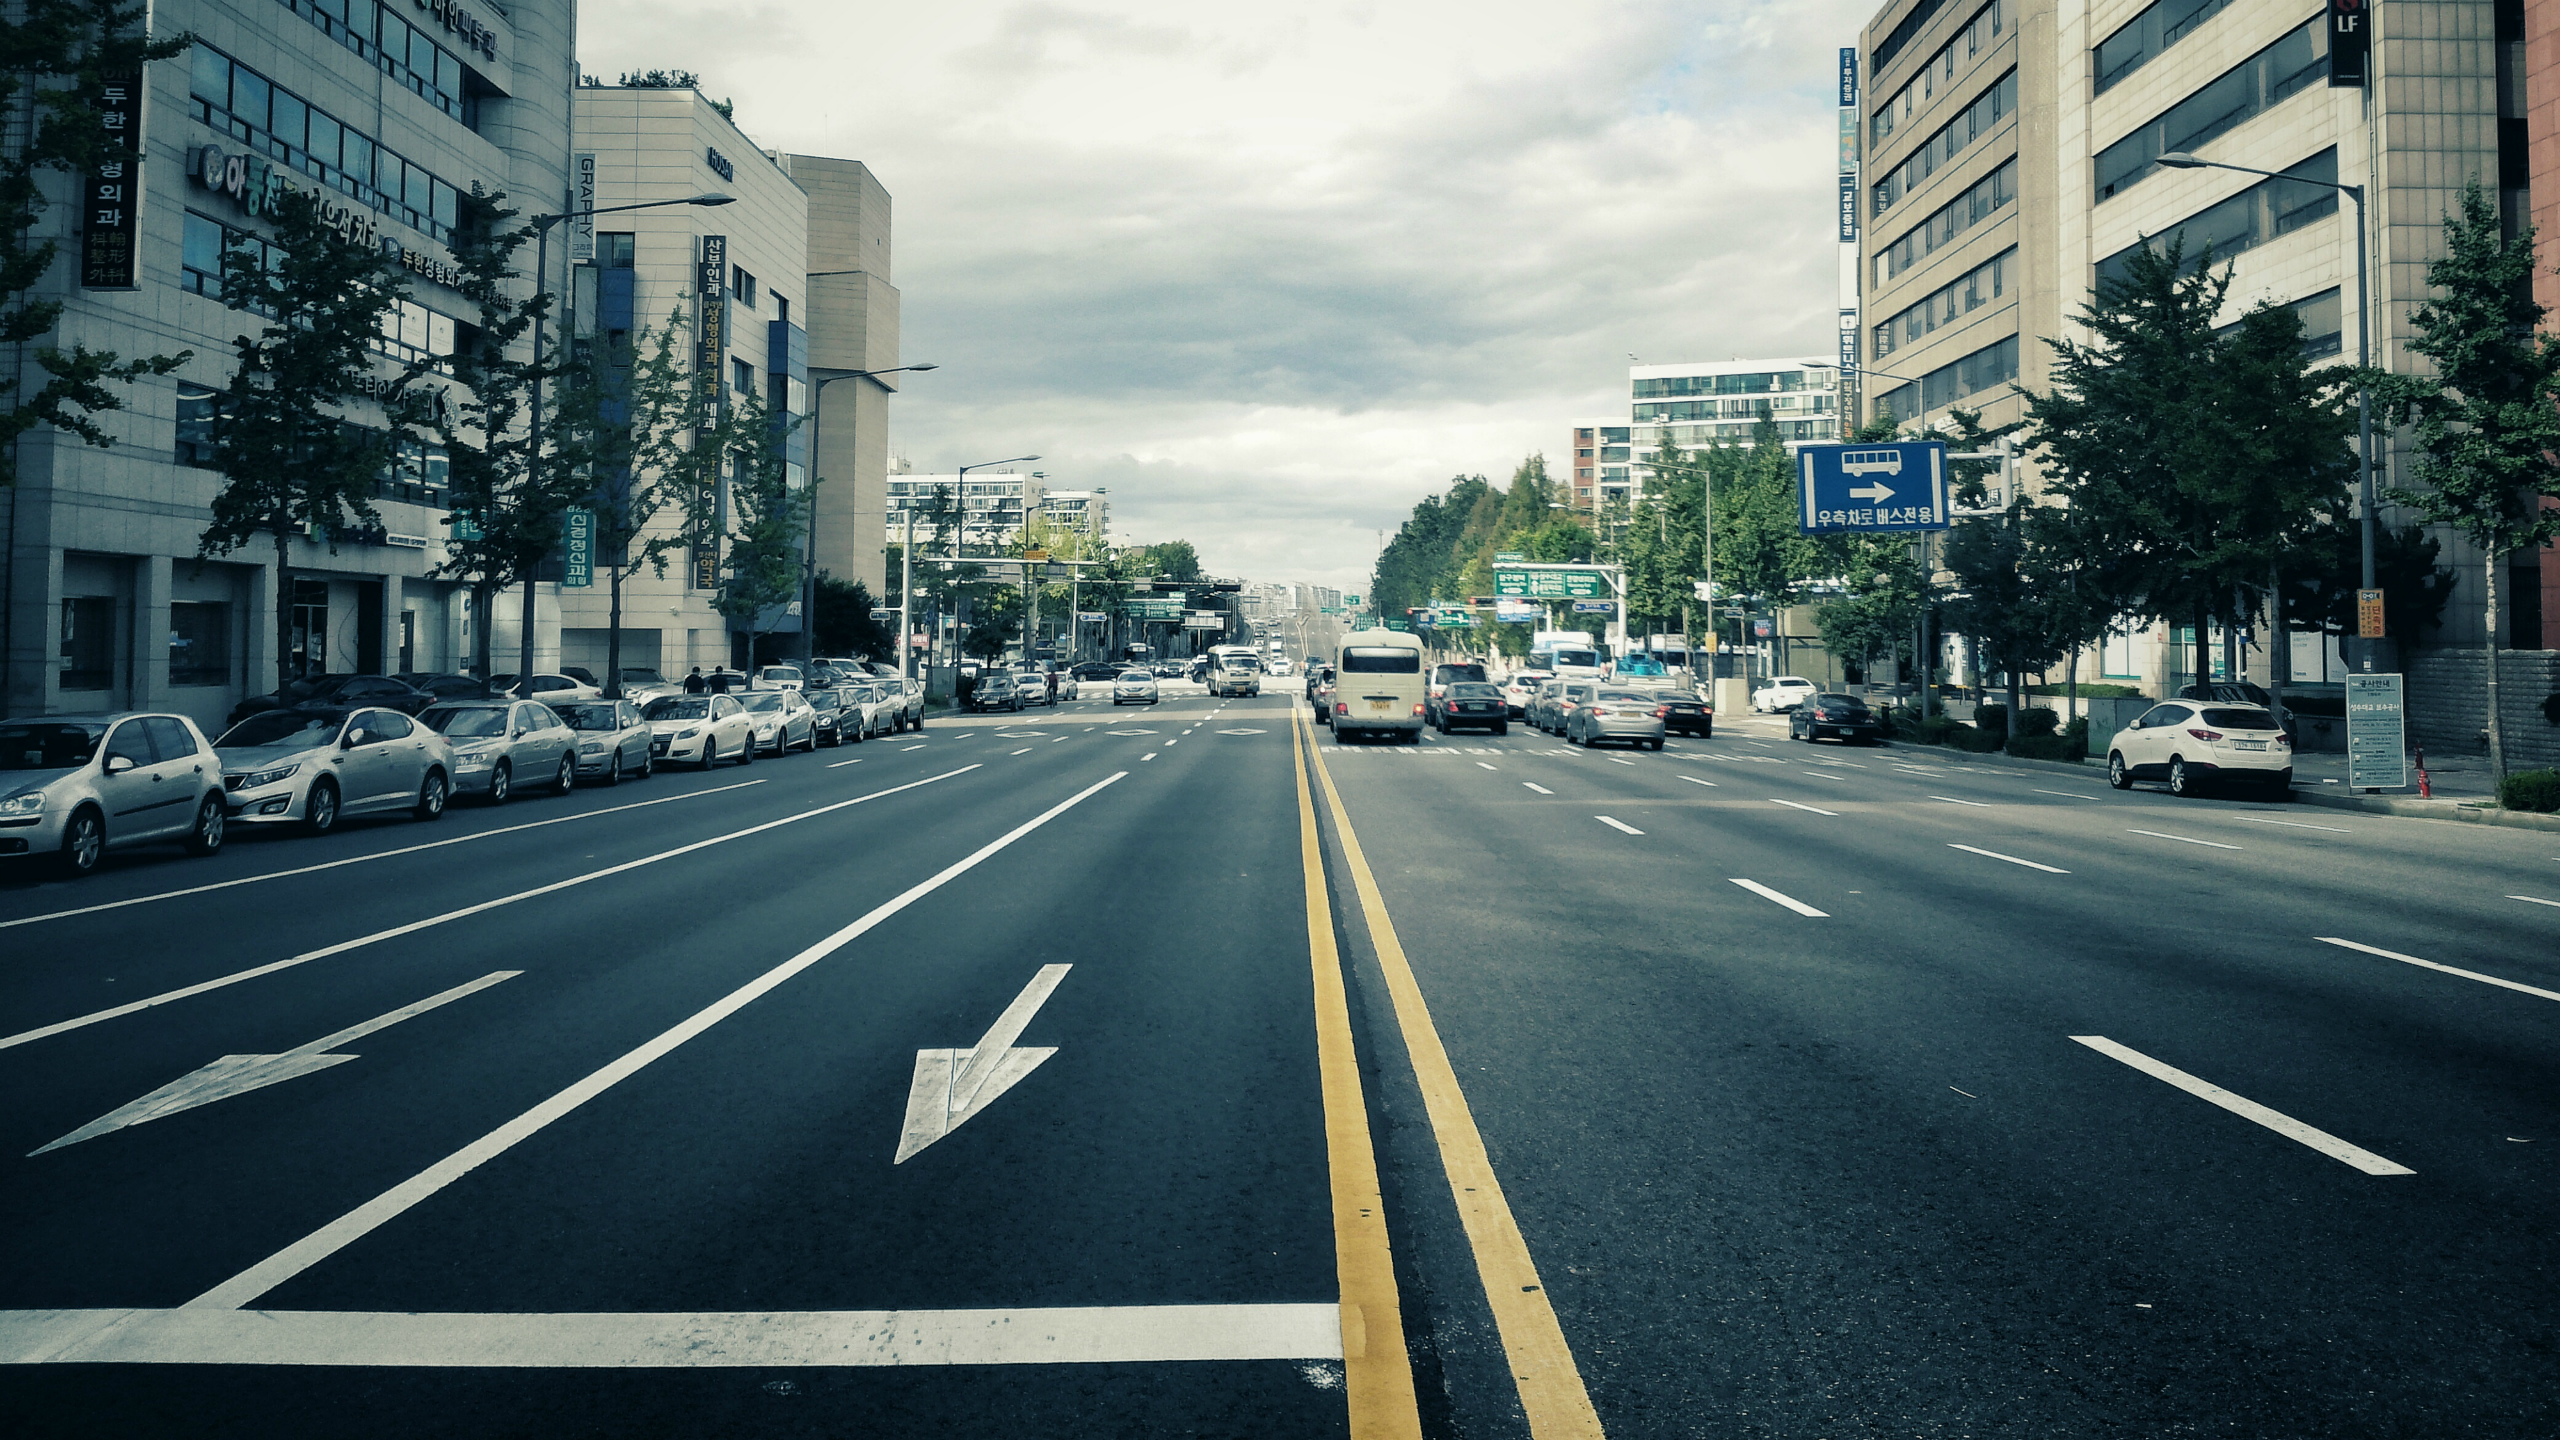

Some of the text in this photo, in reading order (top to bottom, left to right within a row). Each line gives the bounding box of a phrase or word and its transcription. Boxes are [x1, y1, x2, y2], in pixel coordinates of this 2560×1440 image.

[2338, 15, 2358, 32] LF
[579, 158, 594, 239] GRAPHY
[706, 239, 722, 298] 산부인과
[704, 309, 720, 366] 성형외과
[703, 402, 717, 432] 내과
[1817, 506, 1933, 528] 우측차로 버스전용
[568, 514, 587, 577] 신경정신과
[2360, 679, 2390, 688] 공사안내
